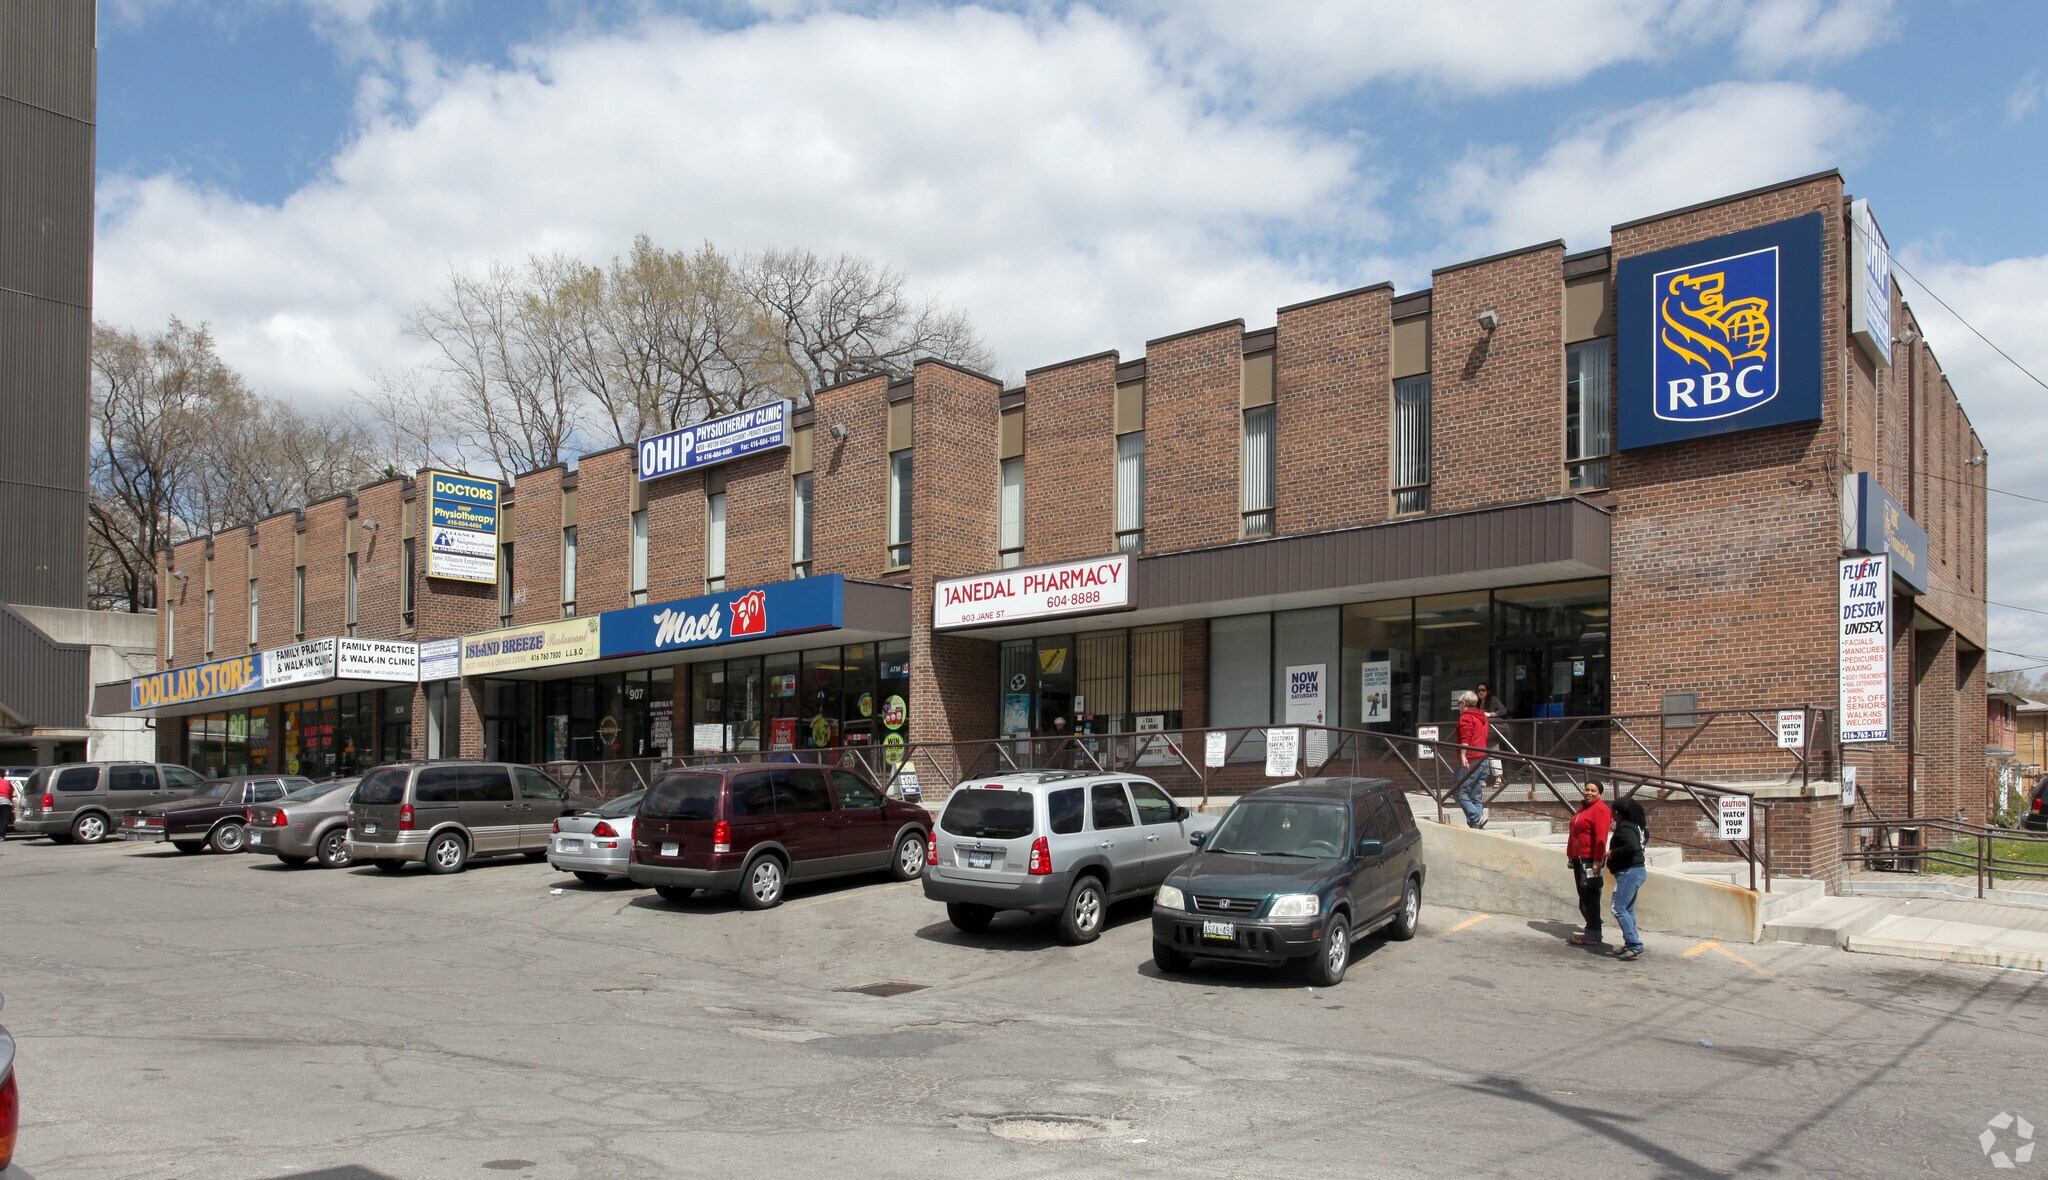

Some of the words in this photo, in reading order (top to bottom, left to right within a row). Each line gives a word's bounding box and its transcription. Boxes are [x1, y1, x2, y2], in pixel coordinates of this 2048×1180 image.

[1866, 212, 1888, 291] OHIP
[1667, 365, 1764, 411] RBC
[748, 428, 761, 438] PRIVATE
[761, 423, 781, 435] INSURANCE
[642, 431, 695, 476] OHIP
[696, 412, 755, 442] PHYSIOTHERAPY
[756, 404, 782, 425] CLINIC
[436, 481, 493, 501] DOCTORS
[434, 507, 495, 525] Physiotherapy
[443, 555, 463, 564] Alliance
[464, 557, 494, 568] Employment
[1843, 561, 1882, 580] FLUENT
[944, 577, 1015, 608] JANEDAL
[1024, 562, 1122, 595] PHARMACY
[1849, 581, 1877, 598] HAIR
[1047, 591, 1100, 609] 604-8888
[961, 613, 975, 623] 903
[976, 611, 994, 622] JANE
[995, 609, 1006, 620] ST.
[1843, 600, 1885, 620] DESIGN
[653, 602, 723, 647] Mac's
[1844, 620, 1883, 635] UNISEX
[341, 641, 372, 652] FAMILY
[374, 642, 415, 655] PRACTICE
[464, 639, 500, 660] ISLAND
[501, 634, 543, 654] BREEZE
[546, 630, 588, 647] Restaurant
[1844, 637, 1874, 647] FACIALS
[276, 646, 300, 661] FAMILY
[300, 640, 333, 656] PRACTICE
[530, 653, 540, 661] 416
[540, 652, 549, 661] 760
[1844, 645, 1885, 655] MANICURES
[277, 663, 283, 673] &
[284, 657, 313, 672] WALK-IN
[313, 652, 333, 667] CLINIC
[341, 653, 347, 663] &
[349, 654, 386, 665] WALK-IN
[388, 656, 416, 667] CLINIC
[1042, 649, 1061, 673] copies
[1844, 655, 1884, 664] PEDICURES
[889, 665, 901, 673] ATM
[1844, 664, 1873, 672] WAXING
[139, 667, 199, 707] DOLLAR
[200, 656, 254, 697] STORE
[1291, 671, 1319, 684] NOW
[1858, 672, 1887, 680] TREATMENTS
[629, 688, 644, 701] 907
[1291, 682, 1319, 694] OPEN
[1846, 701, 1887, 710] SENIORS
[1847, 695, 1865, 703] 25%
[1867, 694, 1885, 702] OFF
[1846, 710, 1883, 719] WALK-INS
[1846, 718, 1883, 726] WELCOME
[775, 728, 791, 736] Need
[1843, 730, 1886, 740] 416-762-1997
[1721, 800, 1746, 808] CAUTION
